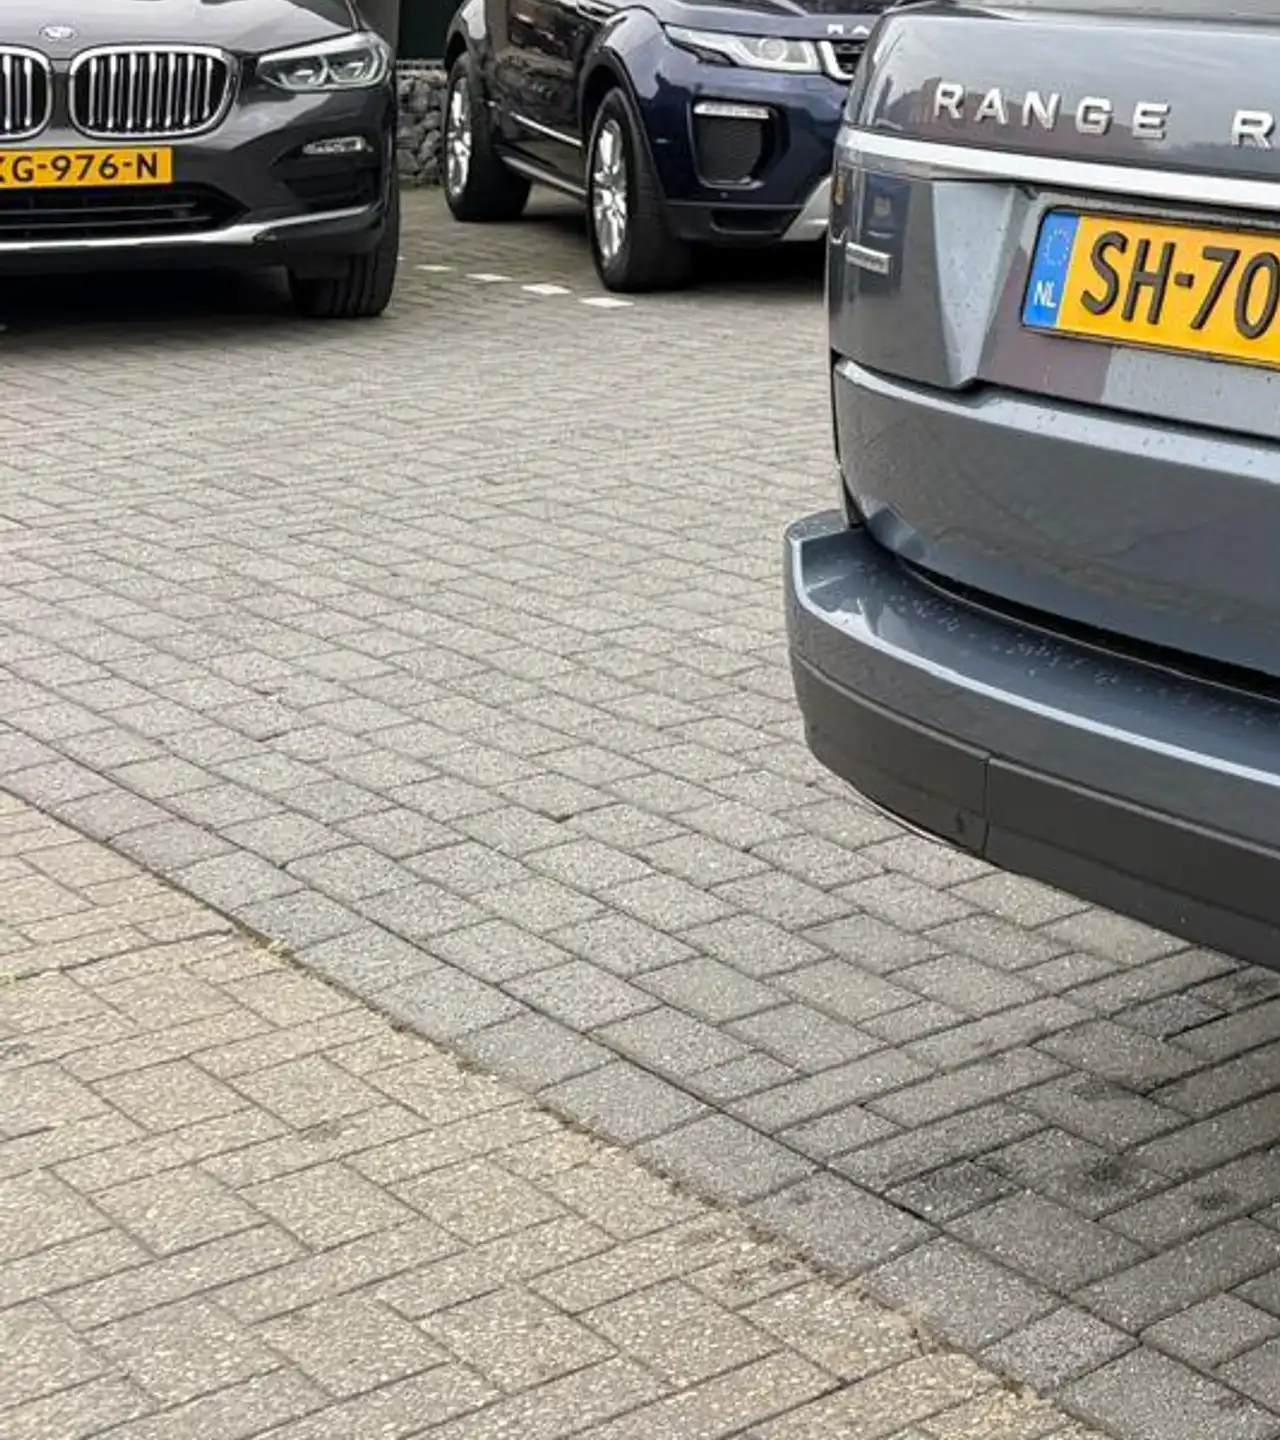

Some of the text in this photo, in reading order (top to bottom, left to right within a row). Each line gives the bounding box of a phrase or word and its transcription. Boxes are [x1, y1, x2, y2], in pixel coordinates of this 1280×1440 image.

[932, 81, 1172, 141] RANGE
[0, 153, 157, 183] G-976-N
[1033, 280, 1058, 308] NL
